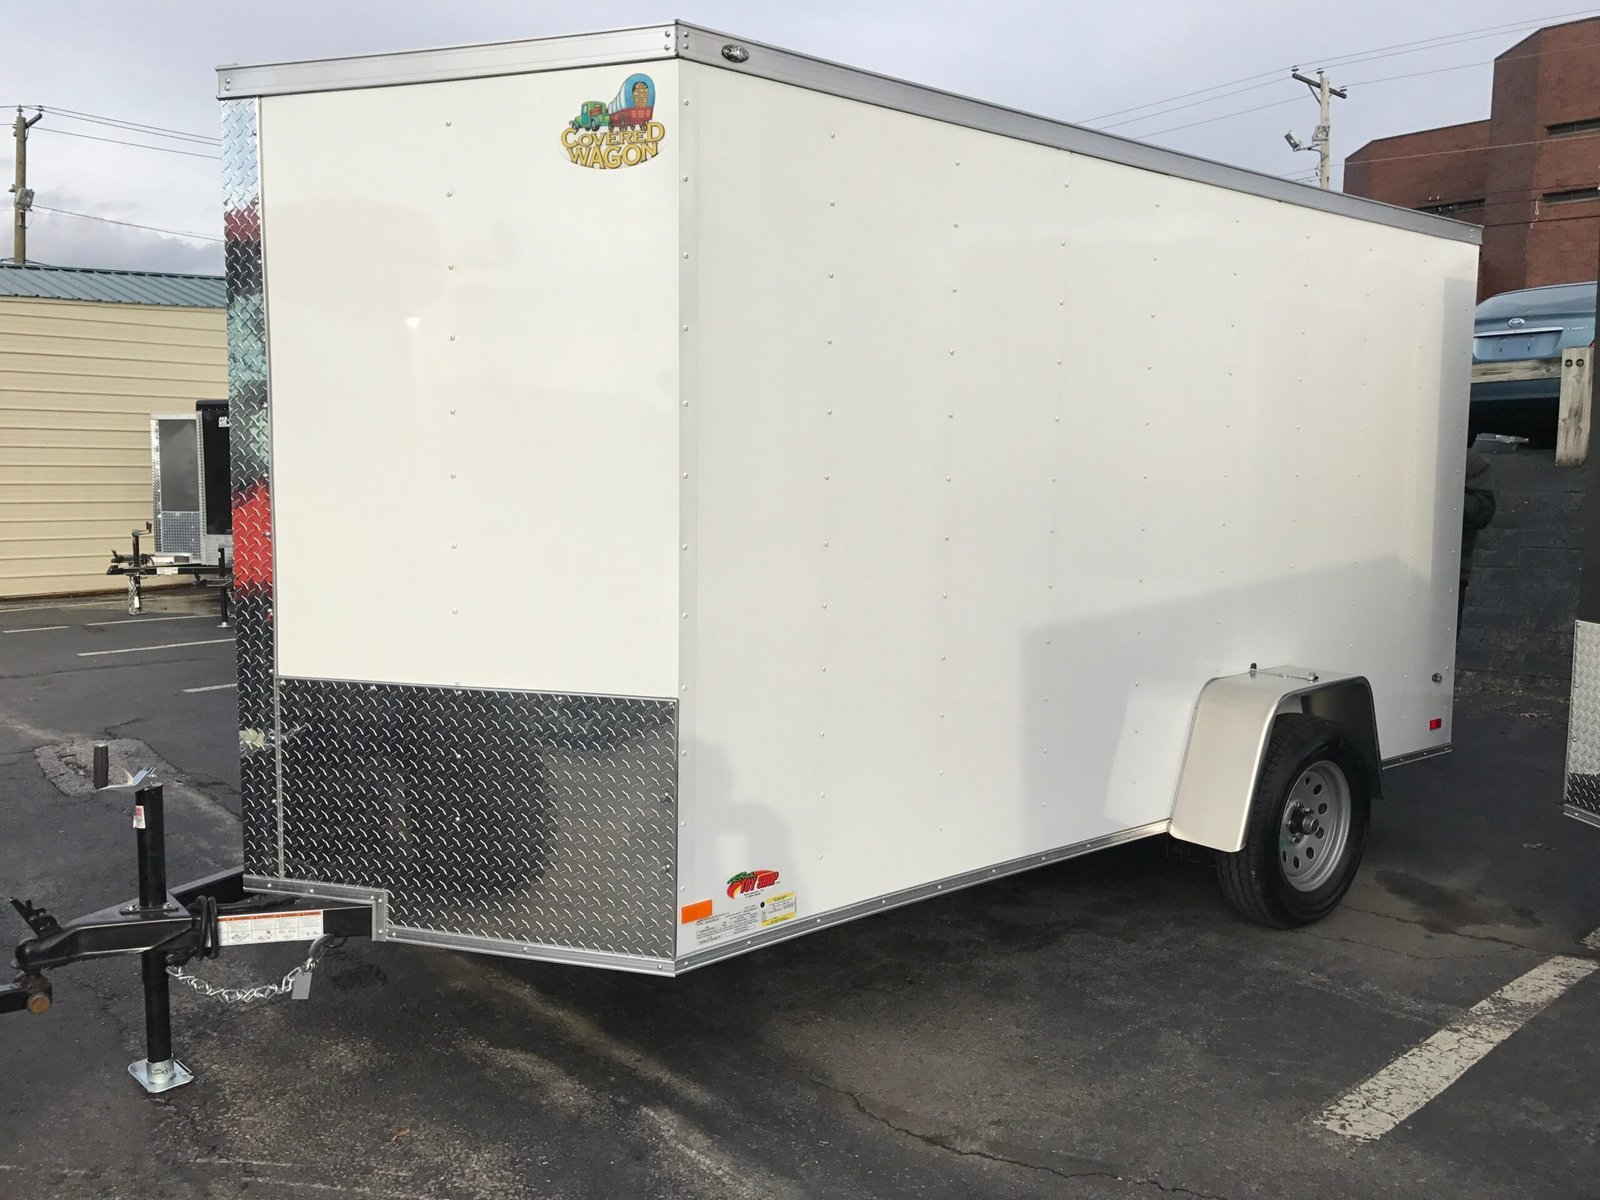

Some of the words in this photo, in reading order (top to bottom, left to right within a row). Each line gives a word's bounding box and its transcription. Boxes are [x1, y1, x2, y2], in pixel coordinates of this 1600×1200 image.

[560, 122, 666, 148] COVERED
[566, 143, 659, 169] WAGON
[740, 877, 758, 893] TOY
[757, 872, 779, 889] SHOP
